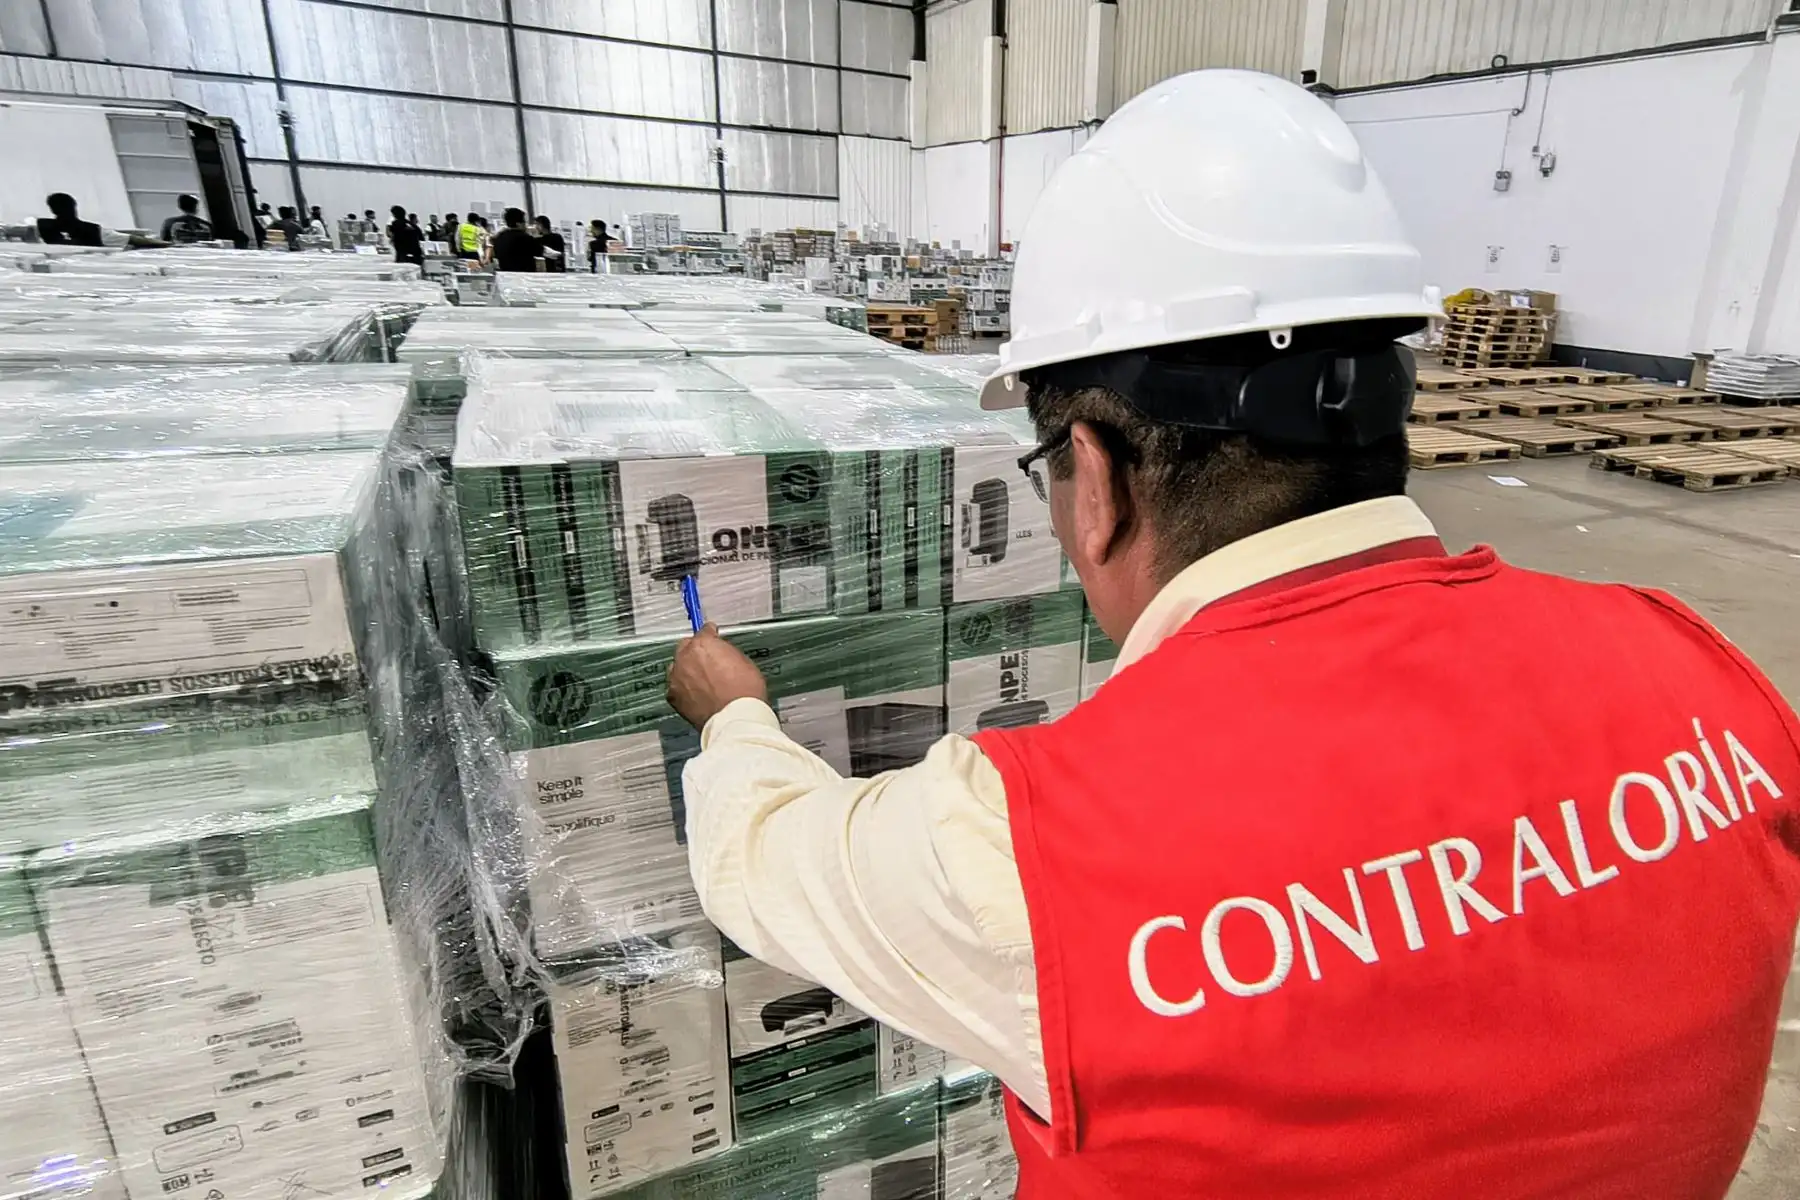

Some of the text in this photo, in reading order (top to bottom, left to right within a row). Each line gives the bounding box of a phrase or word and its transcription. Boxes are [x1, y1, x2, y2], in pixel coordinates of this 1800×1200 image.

[1000, 653, 1020, 703] NPE
[537, 776, 584, 794] Keep it
[539, 788, 584, 805] simple
[1127, 717, 1782, 1017] CONTRALORÍA
